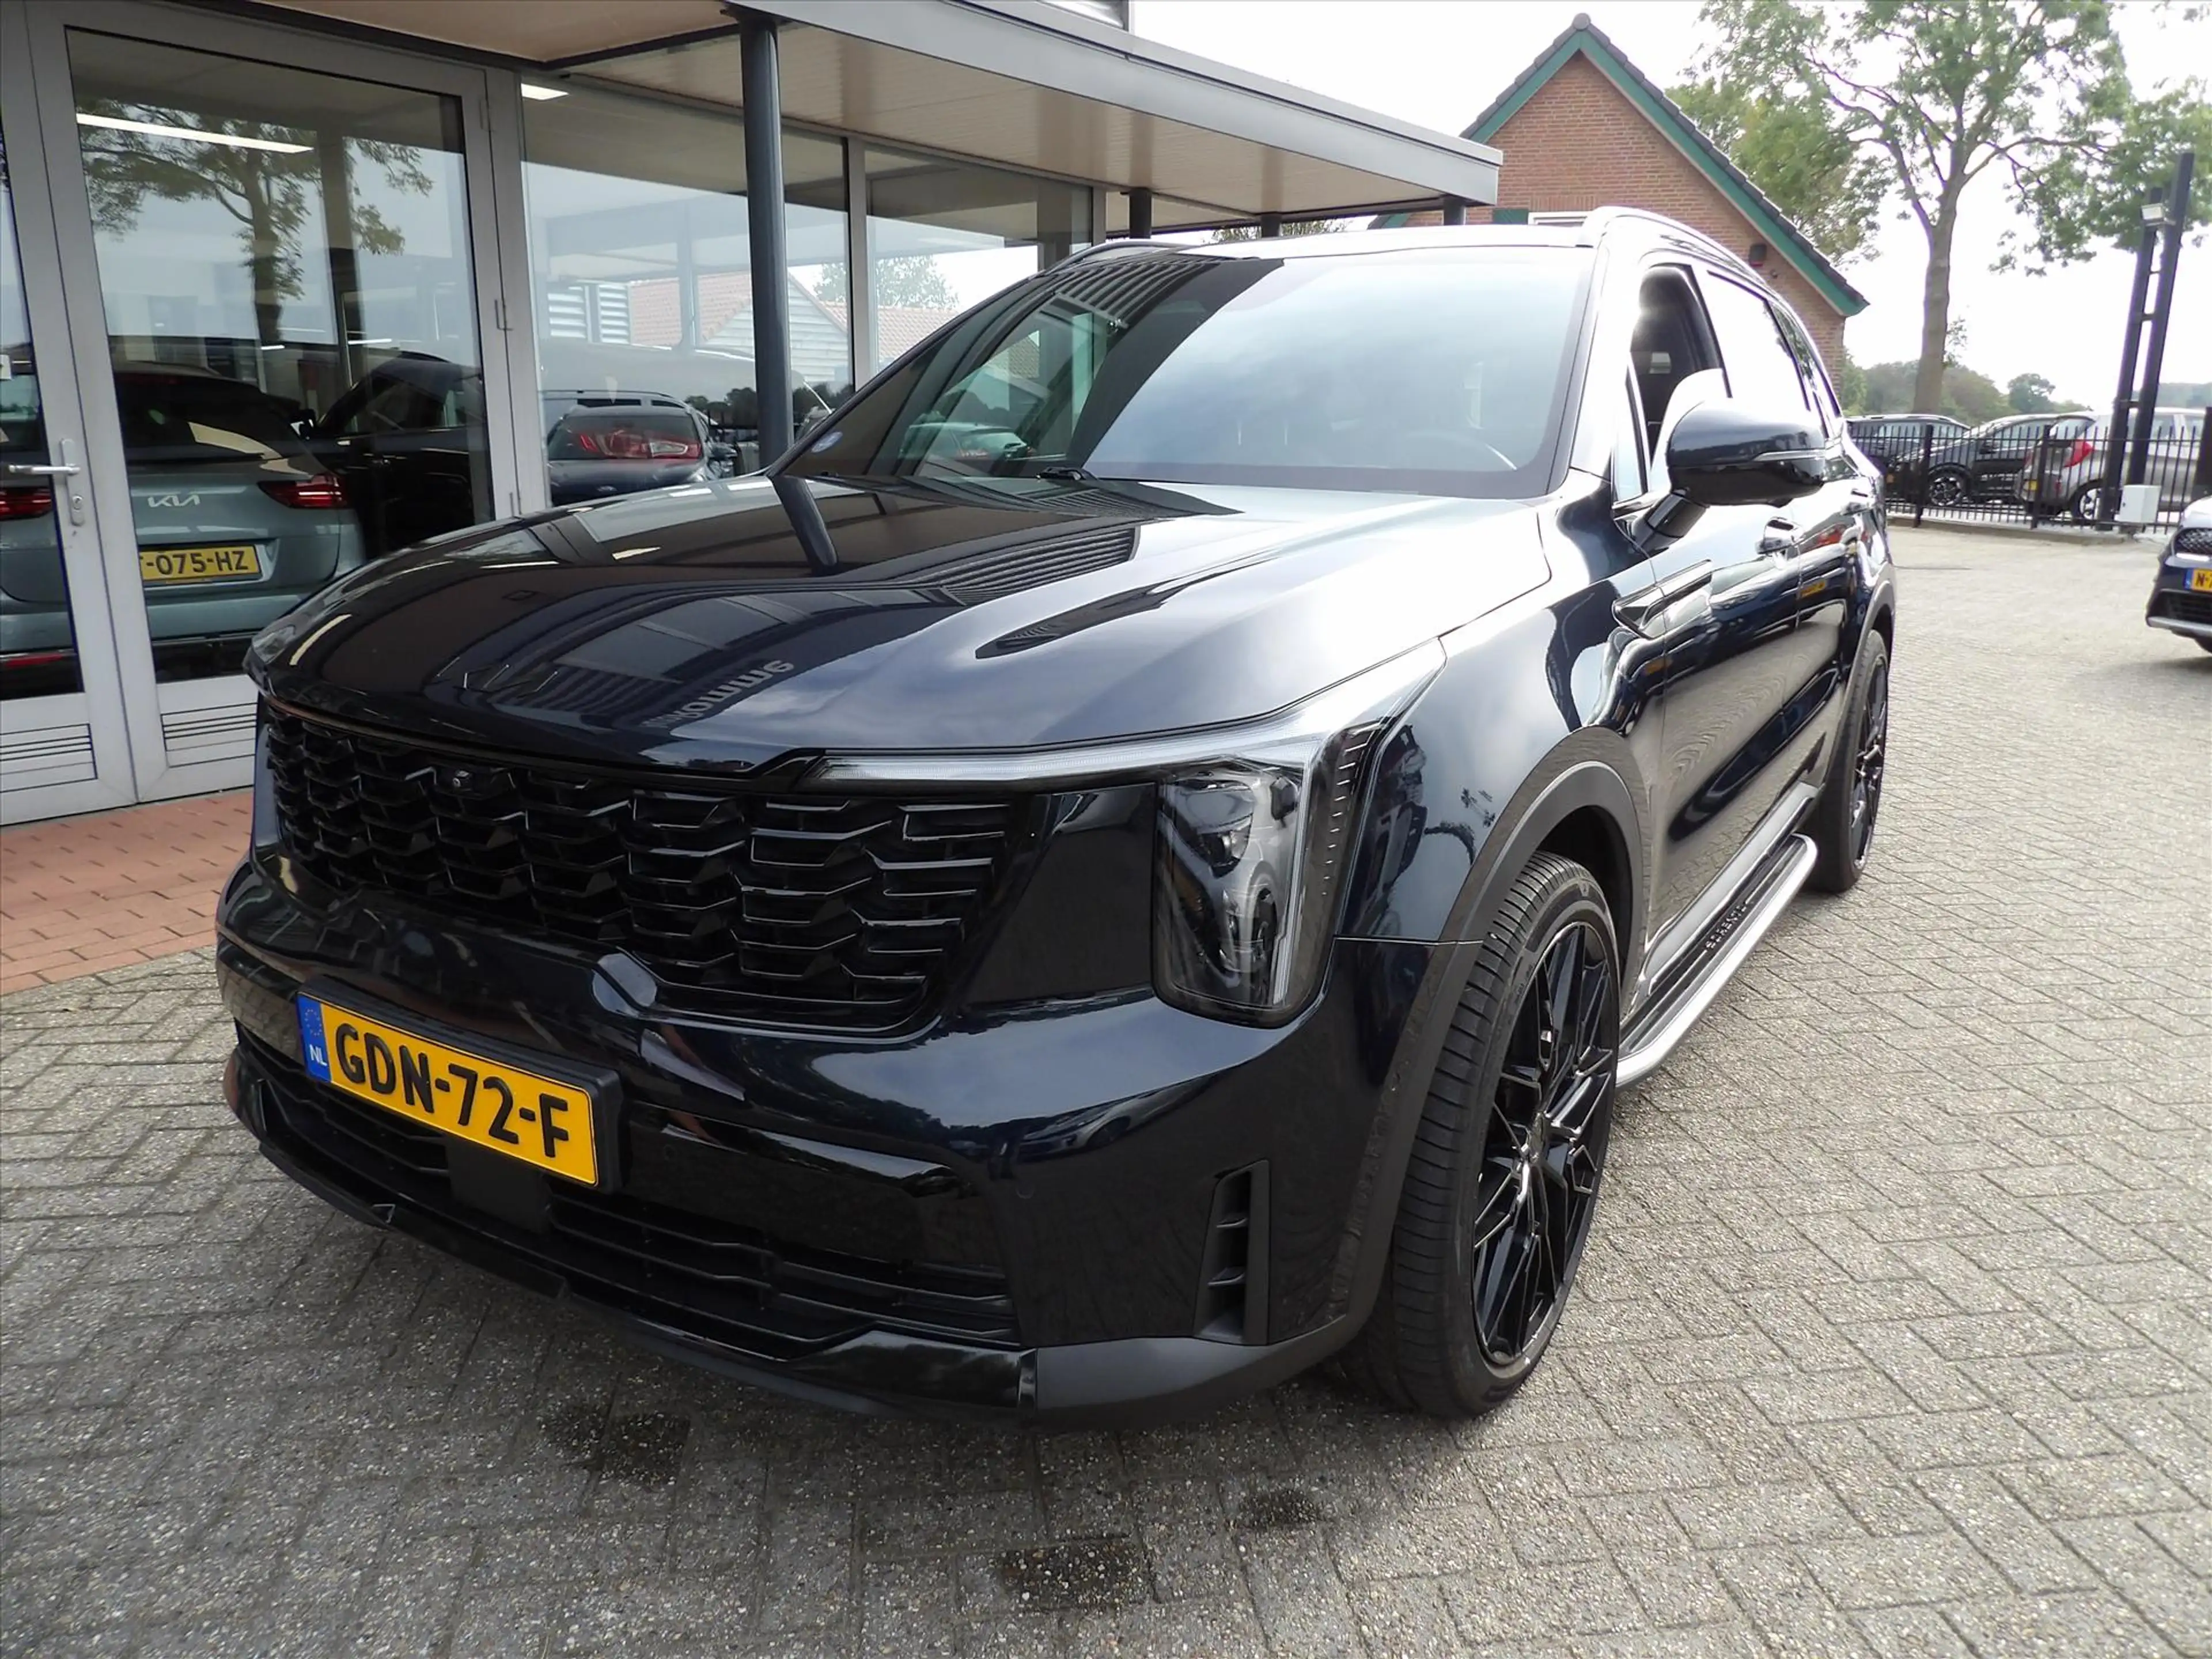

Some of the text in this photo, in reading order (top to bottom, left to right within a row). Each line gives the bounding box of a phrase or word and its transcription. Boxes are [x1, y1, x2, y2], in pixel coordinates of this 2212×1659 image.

[147, 494, 200, 507] KIA
[139, 551, 248, 575] -075-HZ
[309, 1044, 328, 1067] NL
[335, 1022, 569, 1158] GDN-72-F
